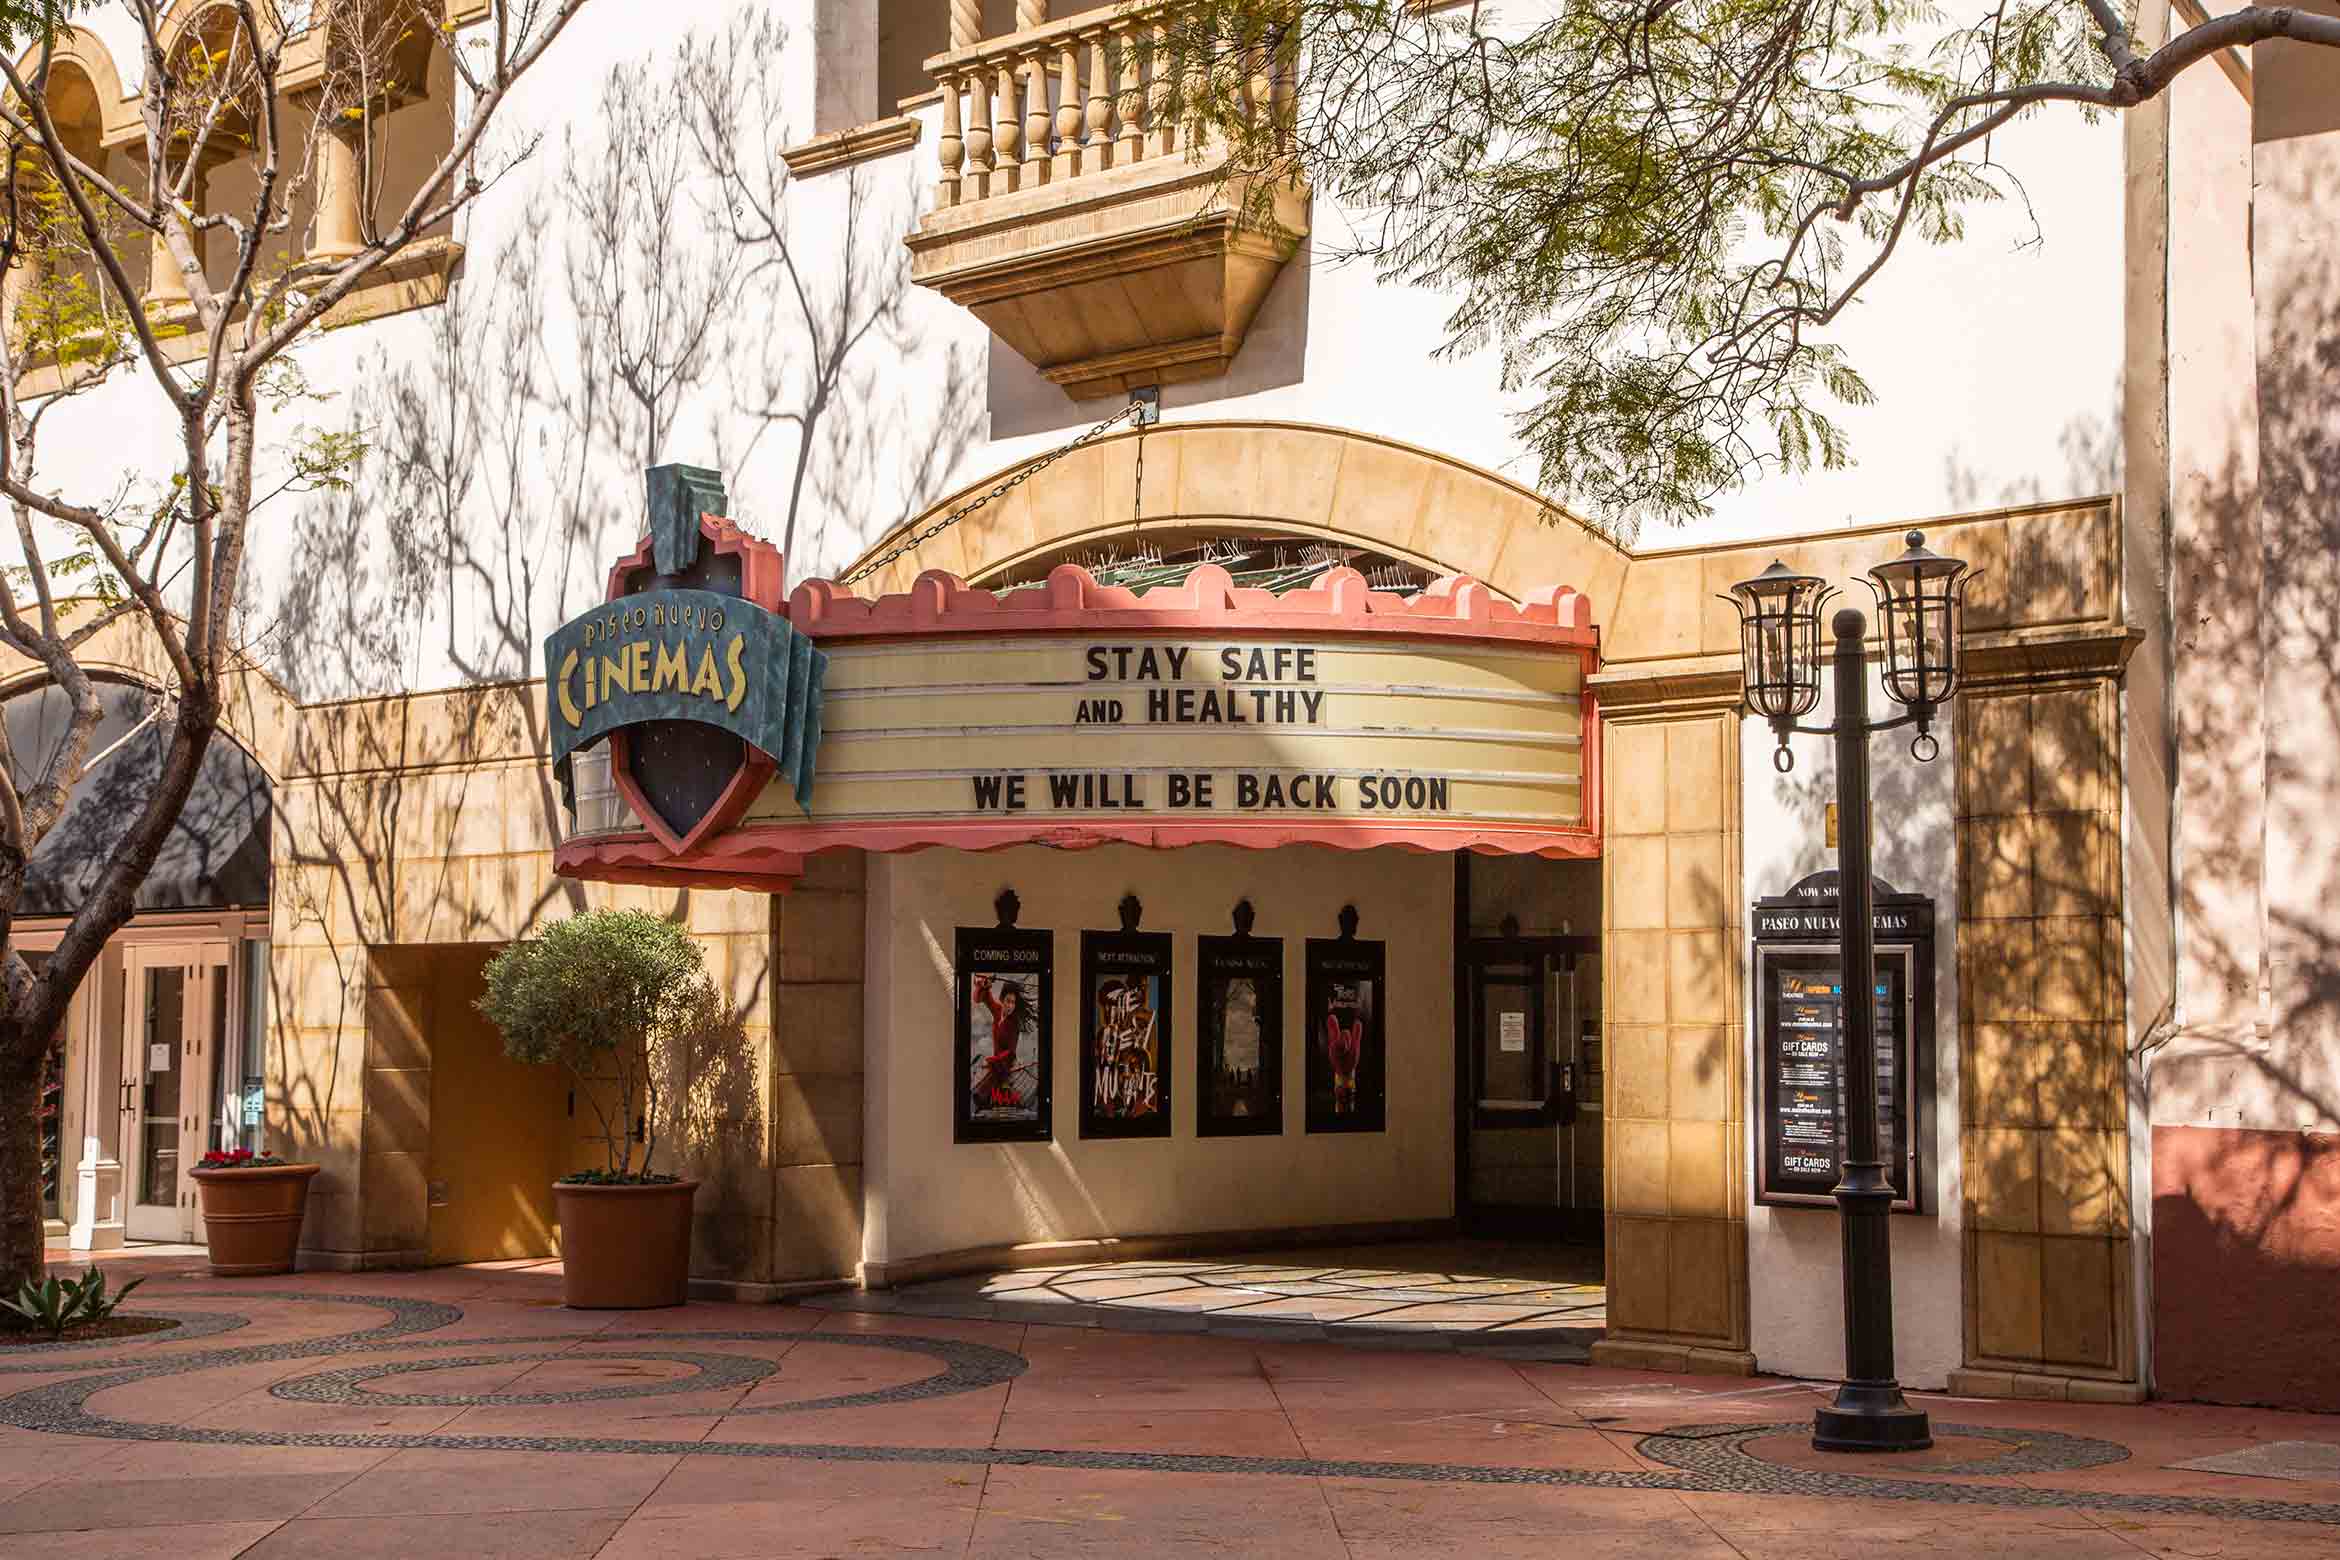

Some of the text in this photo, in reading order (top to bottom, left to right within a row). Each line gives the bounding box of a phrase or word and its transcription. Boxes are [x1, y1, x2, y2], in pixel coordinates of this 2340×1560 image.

[1087, 646, 1316, 681] STAY SAFE
[558, 632, 747, 728] CINEMAS
[1076, 689, 1324, 723] AND HEALTHY
[972, 774, 1448, 810] WE WILL BE BACK SOON
[1797, 887, 1819, 897] NOW
[1761, 917, 1799, 930] PASEO
[1873, 916, 1908, 929] EMAS
[974, 950, 1039, 961] COMING SOON
[1783, 1041, 1829, 1053] GIFT CARDS
[1784, 1156, 1831, 1168] GIFT CARDS
